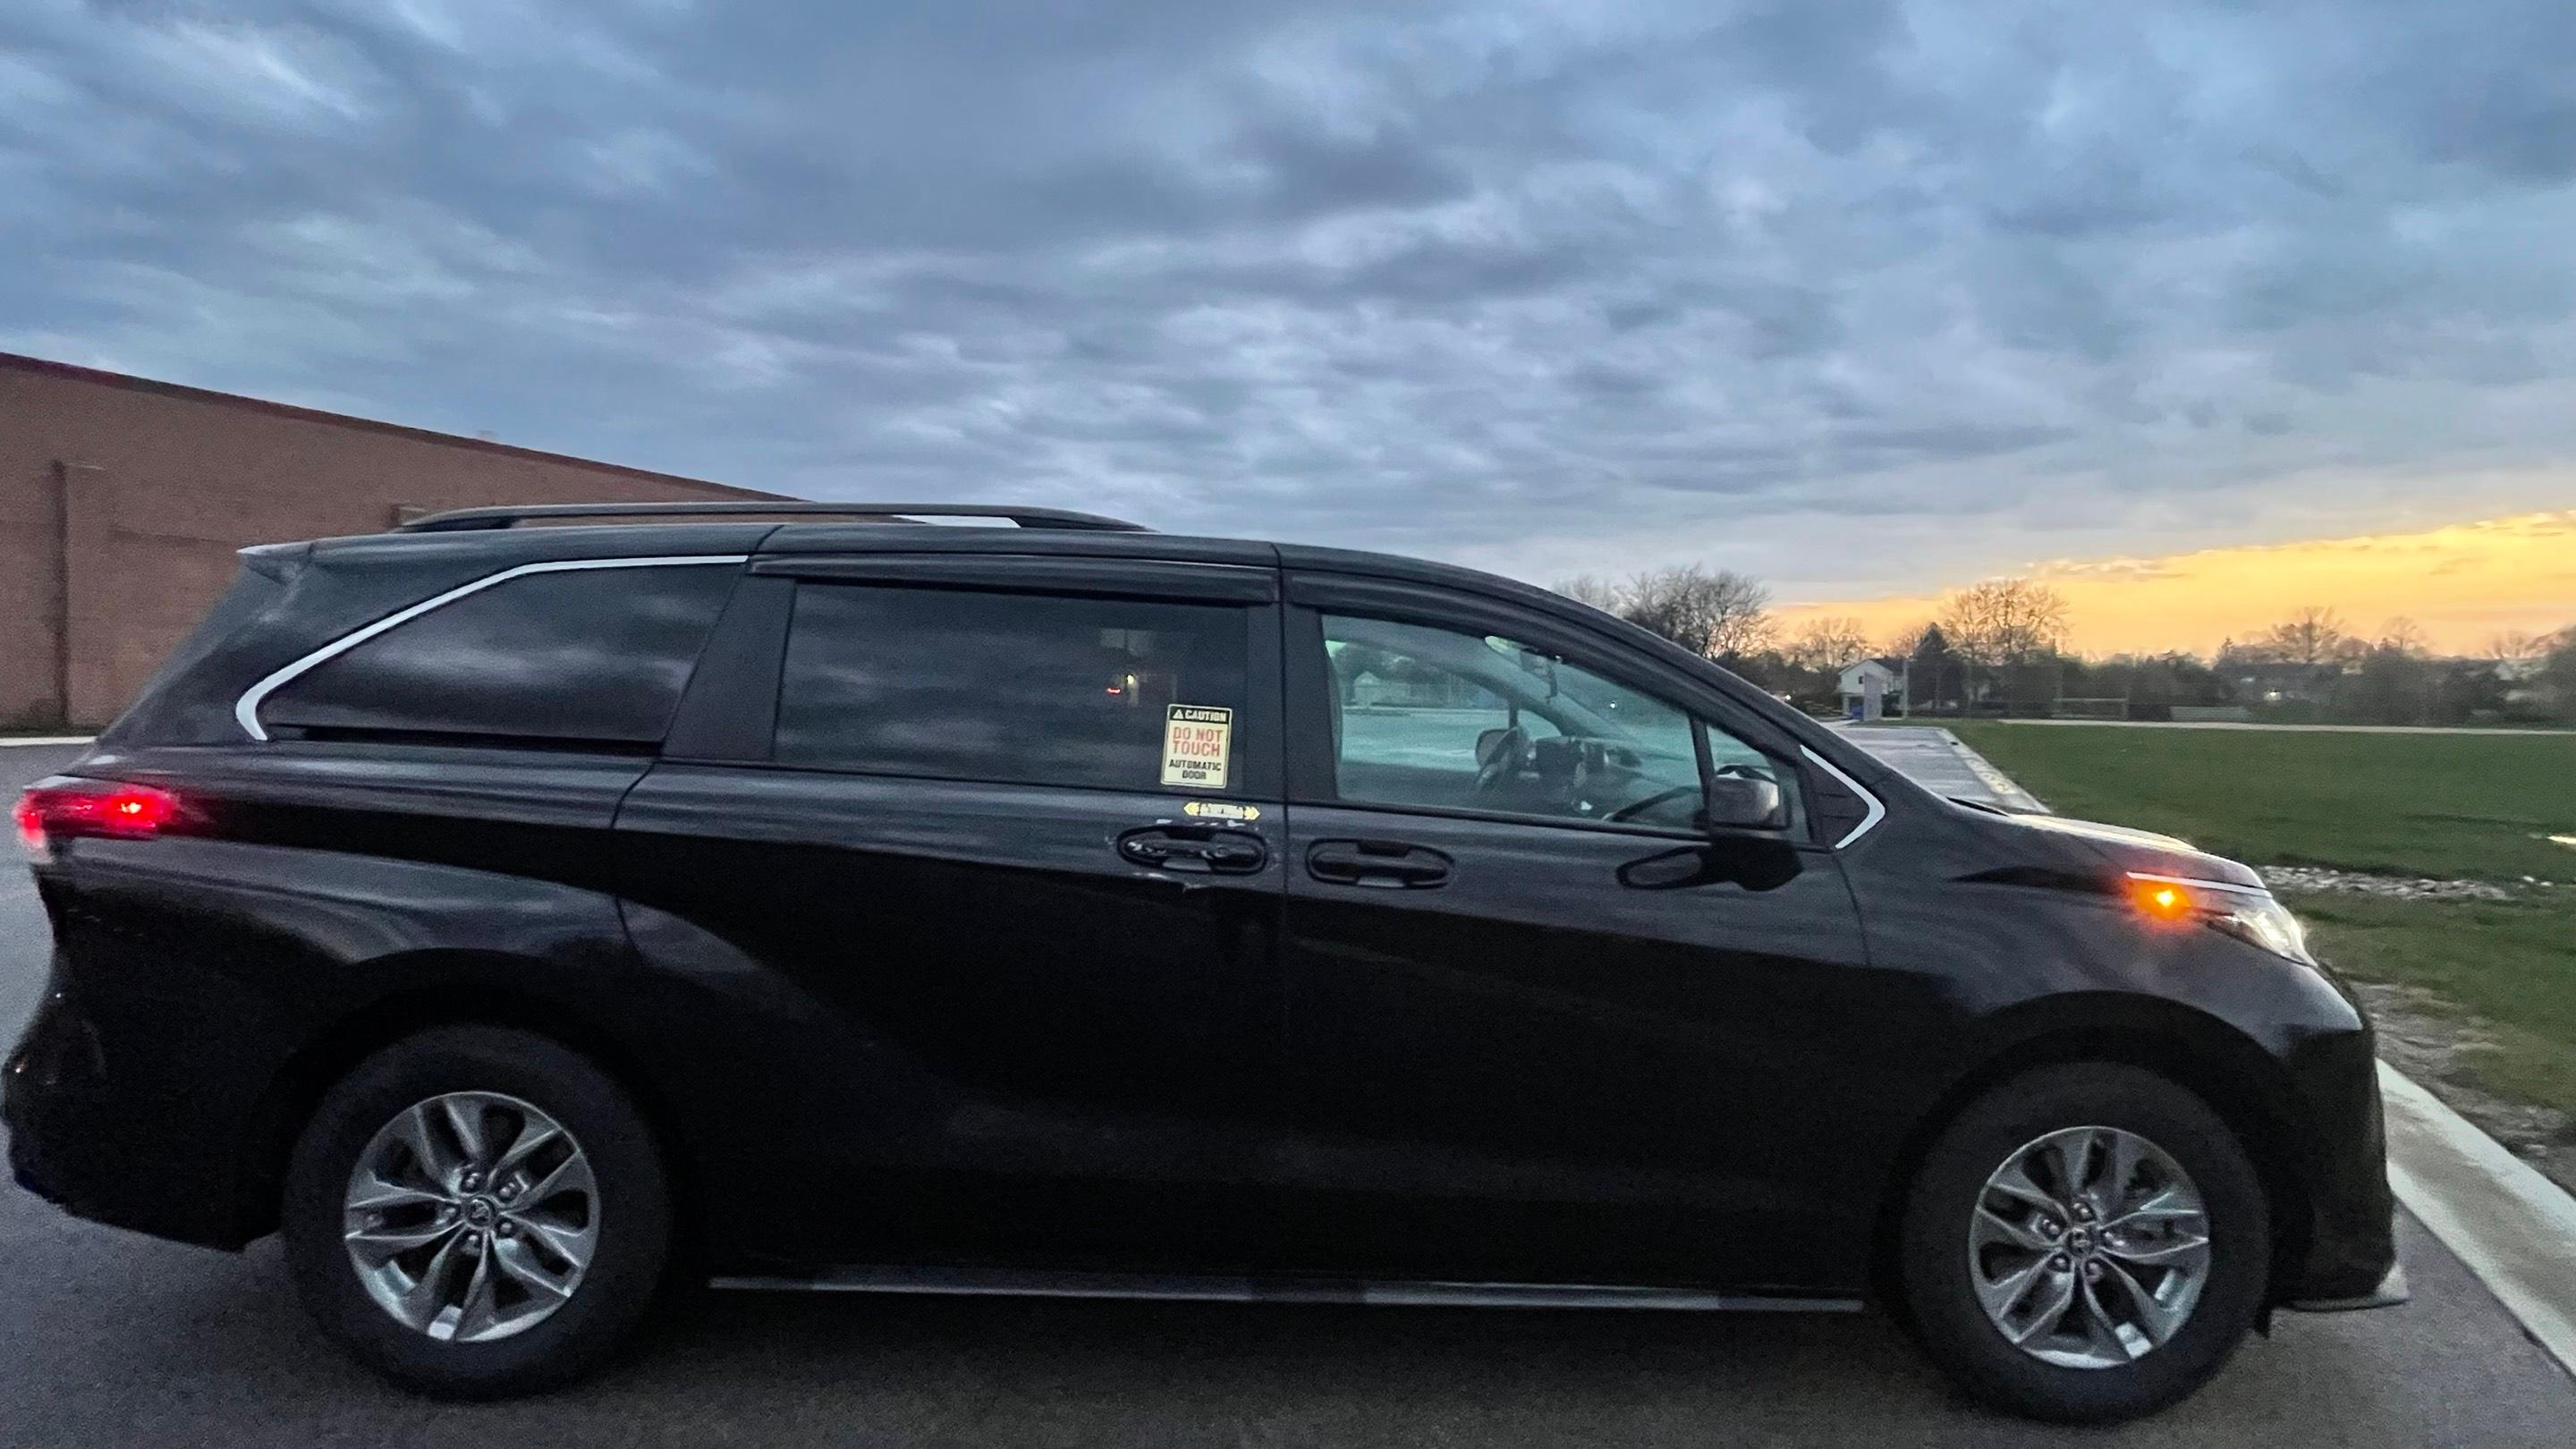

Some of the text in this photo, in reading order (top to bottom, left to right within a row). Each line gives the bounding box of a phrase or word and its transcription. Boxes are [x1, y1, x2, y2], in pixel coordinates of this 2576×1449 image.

[1185, 709, 1227, 722] CAUTION
[1174, 726, 1223, 742] DO NOT
[1173, 741, 1220, 757] TOUCH
[1168, 758, 1221, 771] AUTOMATIC
[1182, 770, 1207, 780] DOOR
